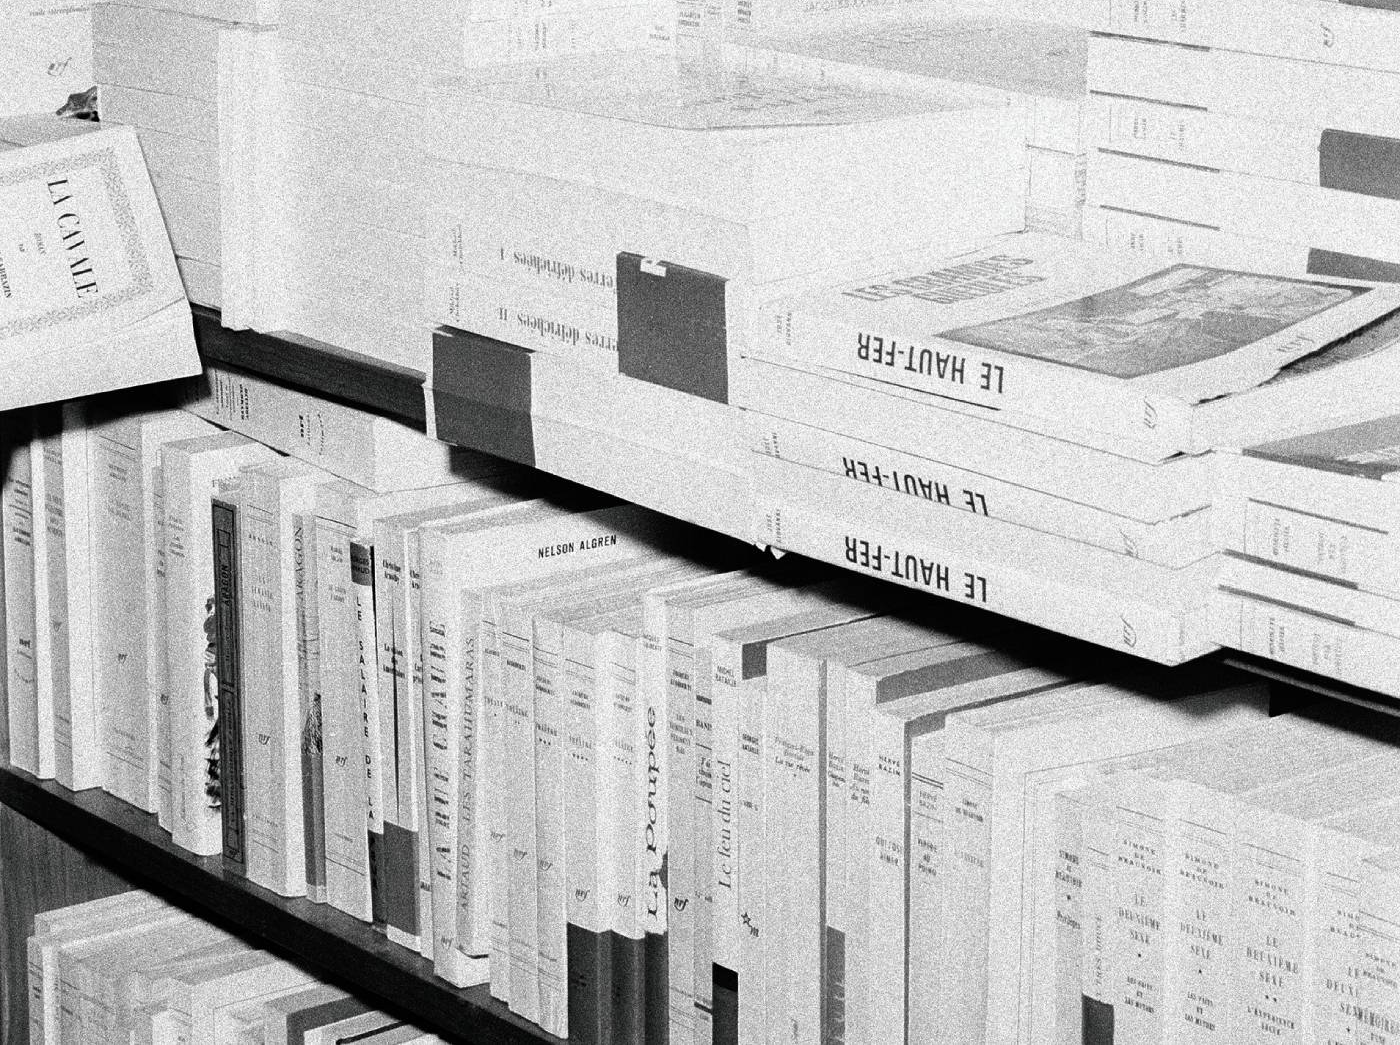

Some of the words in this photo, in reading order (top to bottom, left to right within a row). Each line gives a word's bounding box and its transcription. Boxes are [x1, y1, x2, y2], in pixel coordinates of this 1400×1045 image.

[47, 179, 73, 206] LA
[56, 212, 99, 299] CAVALE
[513, 251, 576, 284] défrichées
[578, 268, 616, 291] erres
[517, 313, 580, 346] défrichées
[584, 331, 619, 352] erres
[857, 332, 966, 384] HAUT-FER
[980, 362, 1004, 394] LE
[842, 456, 951, 506] HAUT-FER
[962, 489, 989, 516] LE
[538, 540, 575, 559] NELSON
[579, 535, 617, 554] ALGREN
[293, 525, 304, 602] ARAGON
[844, 535, 949, 591] HAUT-FER
[964, 572, 987, 602] LE
[358, 640, 369, 737] SALAIRE
[462, 637, 474, 781] TARAHUMARAS
[365, 755, 372, 779] DE
[644, 705, 659, 852] poupée
[717, 761, 731, 791] ciel
[878, 763, 900, 776] BAZIN
[368, 796, 374, 820] LA
[462, 791, 471, 822] LES
[717, 801, 731, 824] du
[1123, 840, 1155, 855] SIMONE
[1185, 853, 1219, 869] SIMONE
[436, 846, 451, 881] LA
[717, 863, 731, 889] Le
[1118, 856, 1161, 874] BEAUVOIR
[460, 843, 470, 913] ARTAUD
[1180, 870, 1224, 889] BEAUVOIR
[1254, 879, 1288, 894] SIMONE
[647, 867, 659, 917] La
[1248, 895, 1296, 916] BEAUVOIR
[1338, 910, 1360, 921] SIMO
[1190, 945, 1210, 959] SEXE
[1246, 947, 1298, 974] DEUXIÈME
[1259, 971, 1283, 987] SEXE
[1326, 979, 1359, 997] DEUXI
